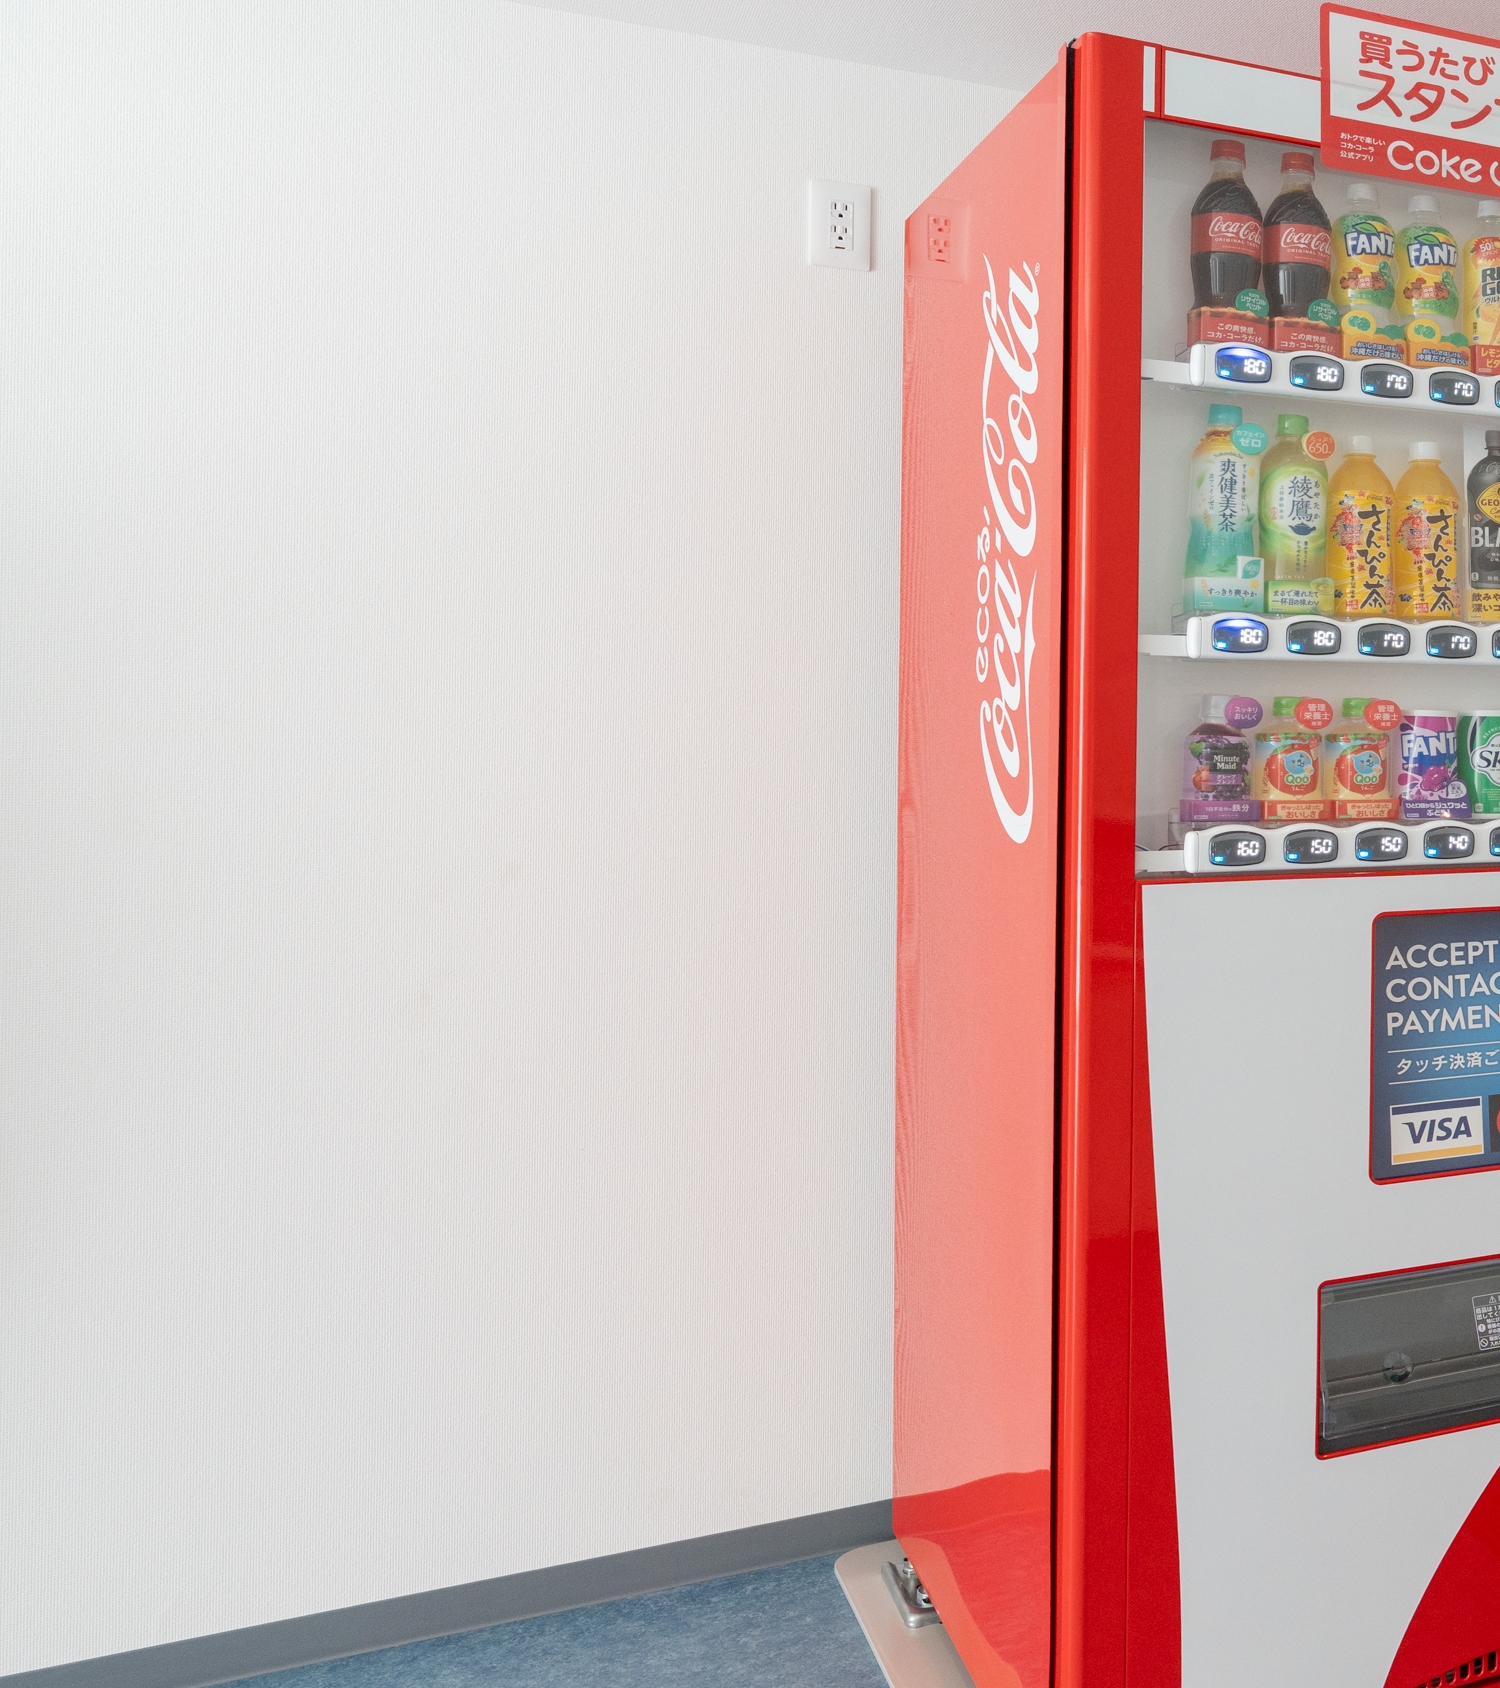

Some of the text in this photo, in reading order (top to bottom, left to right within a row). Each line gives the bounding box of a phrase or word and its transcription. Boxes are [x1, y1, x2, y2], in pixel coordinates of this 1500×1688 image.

[1359, 30, 1496, 86] 買うたび
[1340, 132, 1386, 146] おトクで楽しい
[1340, 141, 1375, 153] コカ・コーラ
[1340, 150, 1374, 162] 公式アプリ
[1387, 140, 1482, 183] Coke
[1206, 331, 1263, 344] コカ・コーラだけ。
[1351, 347, 1403, 361] 沖縄だけの味わい
[1416, 354, 1469, 367] 沖縄だけの味わい
[1243, 358, 1266, 375] 180
[1317, 366, 1338, 382] 180
[1386, 374, 1407, 390] 170
[1454, 381, 1473, 397] 170
[1236, 429, 1265, 438] カフェイン
[1239, 437, 1262, 448] ゼロ
[1217, 458, 1238, 532] 爽健美茶
[1287, 475, 1314, 523] 綾鷹
[980, 253, 1039, 844] Coca-Cola
[1357, 503, 1387, 610] さんぴん茶
[1424, 508, 1455, 613] さんぴん茶
[1207, 588, 1258, 599] すっきり爽やか
[1240, 628, 1262, 644] 180
[1313, 631, 1335, 646] 180
[1384, 633, 1404, 648] 170
[1451, 635, 1470, 650] 170
[1234, 706, 1258, 714] スッキリ
[1234, 712, 1257, 721] おいしく
[1401, 731, 1457, 758] FANT
[1213, 754, 1240, 763] Minute
[1216, 762, 1237, 770] Maid
[1284, 774, 1310, 785] Qoo
[1354, 774, 1379, 785] Qoo
[1286, 811, 1317, 819] おいしさ
[1355, 810, 1386, 818] おいしさ
[1237, 841, 1259, 856] 160
[1310, 839, 1332, 854] 150
[1381, 837, 1401, 852] 150
[1449, 835, 1468, 849] 140
[1385, 940, 1499, 971] ACCEPT
[1401, 1115, 1473, 1145] VISA
